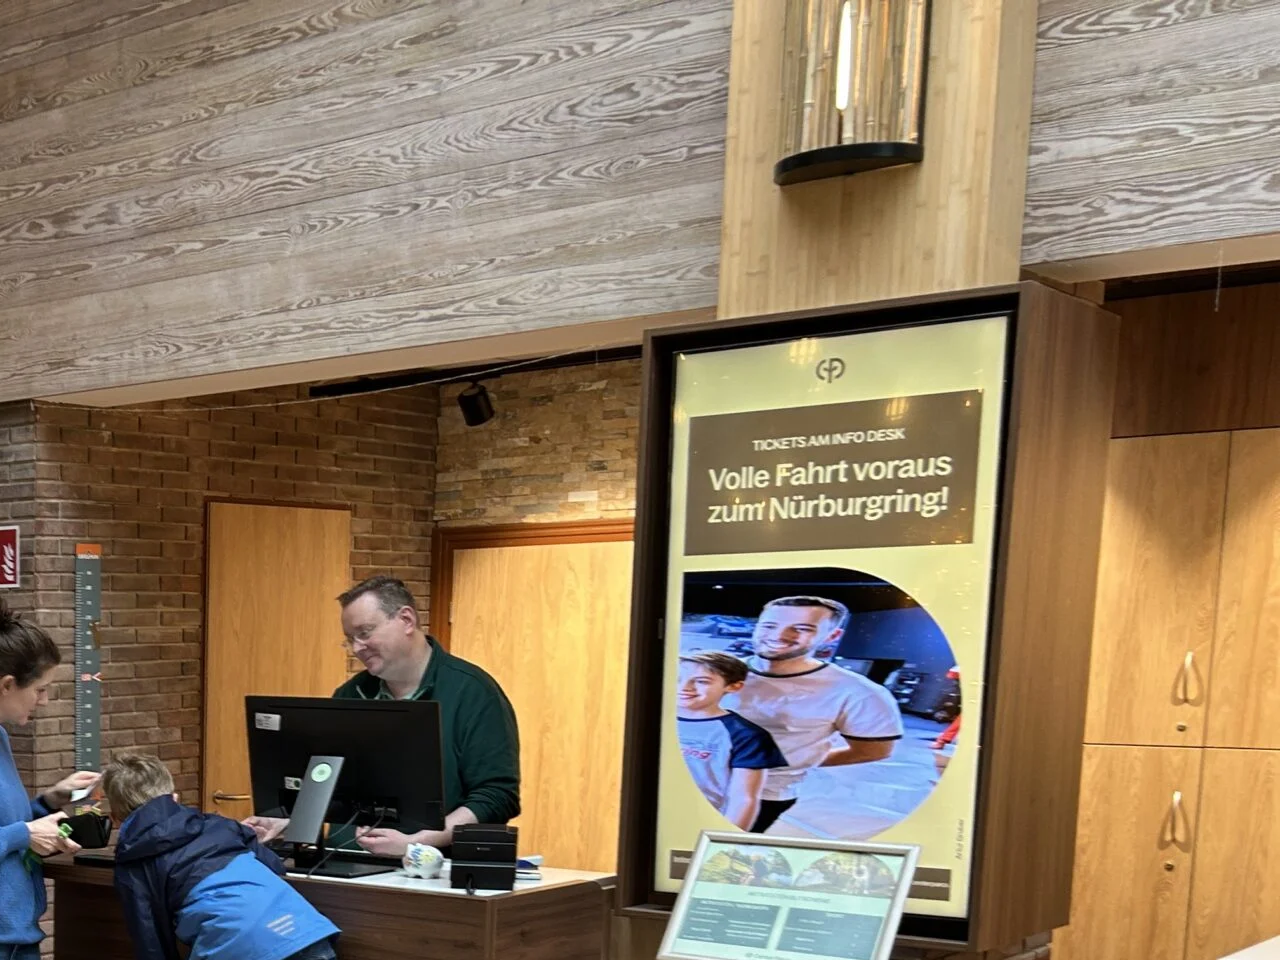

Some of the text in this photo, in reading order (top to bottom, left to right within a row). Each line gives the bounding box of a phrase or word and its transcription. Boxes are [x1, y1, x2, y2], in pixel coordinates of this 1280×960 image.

[752, 428, 906, 451] TICKETS AM INFO DESK
[709, 455, 952, 491] Volle Fahrt voraus
[708, 486, 949, 523] zum Nürburgring!
